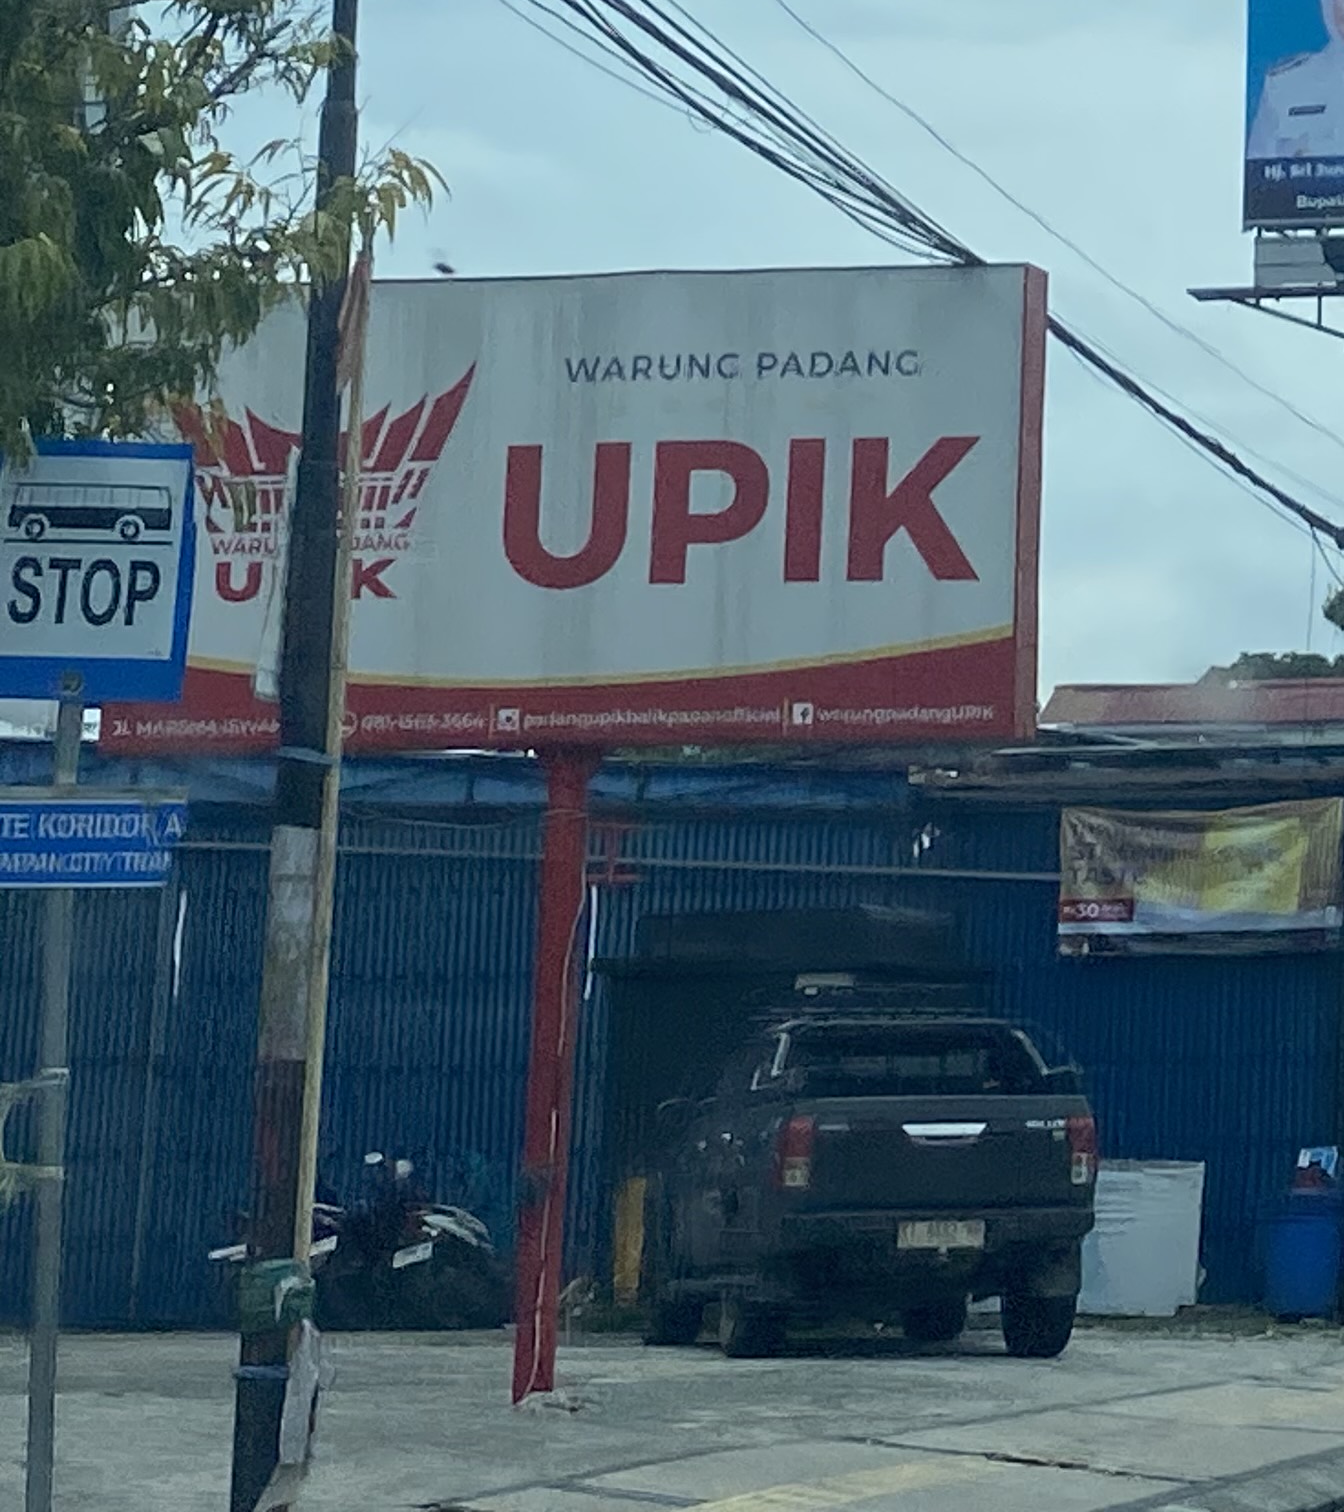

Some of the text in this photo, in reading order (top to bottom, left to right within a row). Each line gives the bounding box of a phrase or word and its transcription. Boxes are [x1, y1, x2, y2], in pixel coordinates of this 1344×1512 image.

[565, 349, 921, 383] WARUNG PADANG
[503, 436, 981, 590] UPIK
[8, 556, 160, 626] STOP
